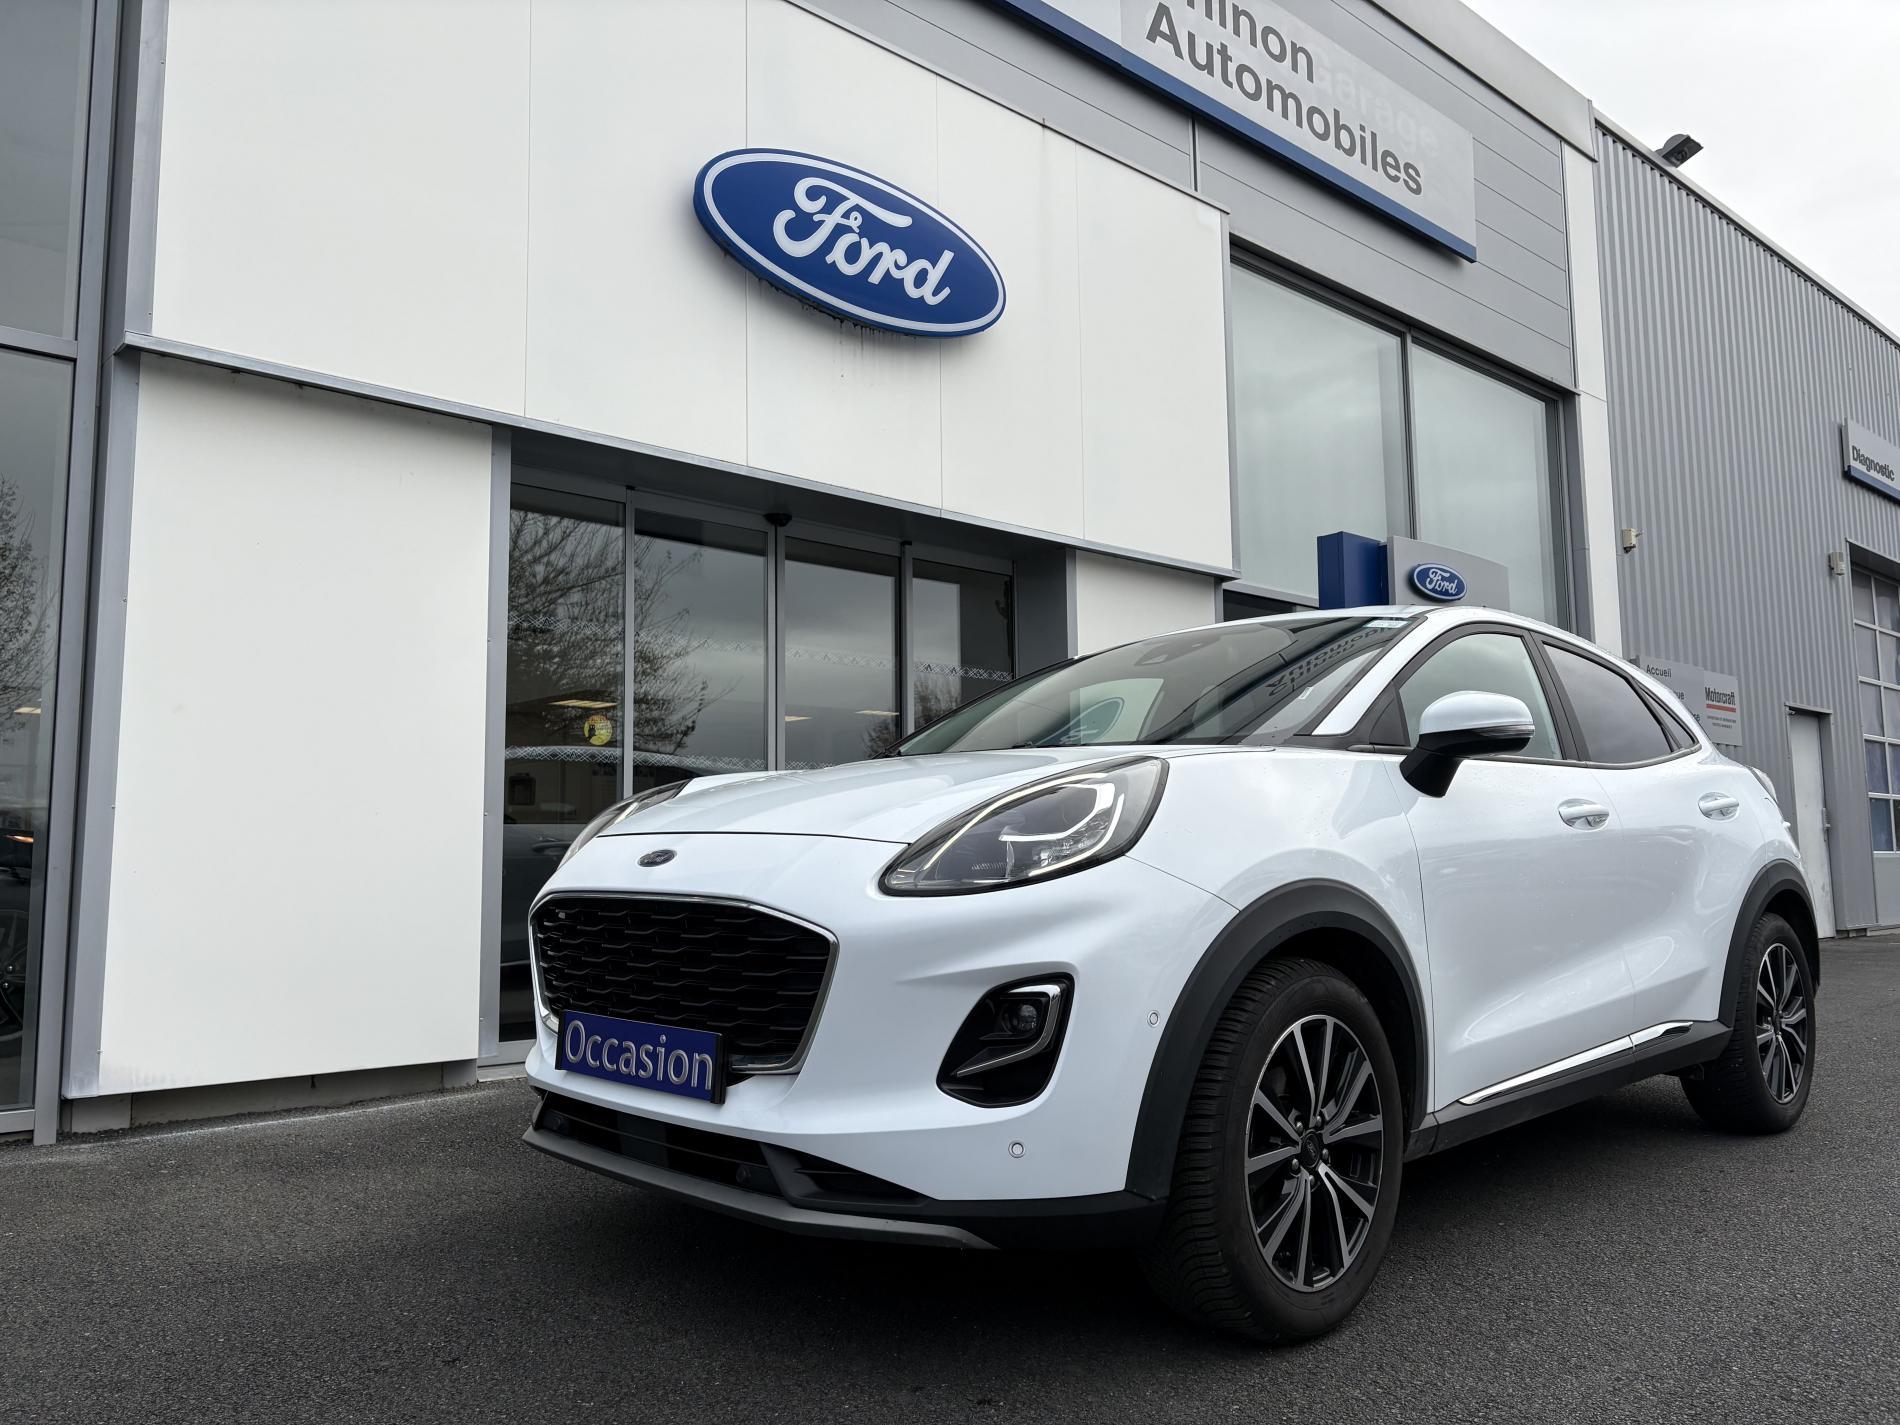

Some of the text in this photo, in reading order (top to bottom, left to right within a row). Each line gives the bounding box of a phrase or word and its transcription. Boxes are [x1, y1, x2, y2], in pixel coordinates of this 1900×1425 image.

[1145, 2, 1422, 196] Automobiles
[773, 177, 955, 306] Ford
[1852, 445, 1895, 481] Diagnostic
[1426, 568, 1458, 594] Ford
[1646, 664, 1672, 678] Accueil
[1704, 686, 1736, 706] Motorcraft
[565, 1019, 713, 1091] Occasion
